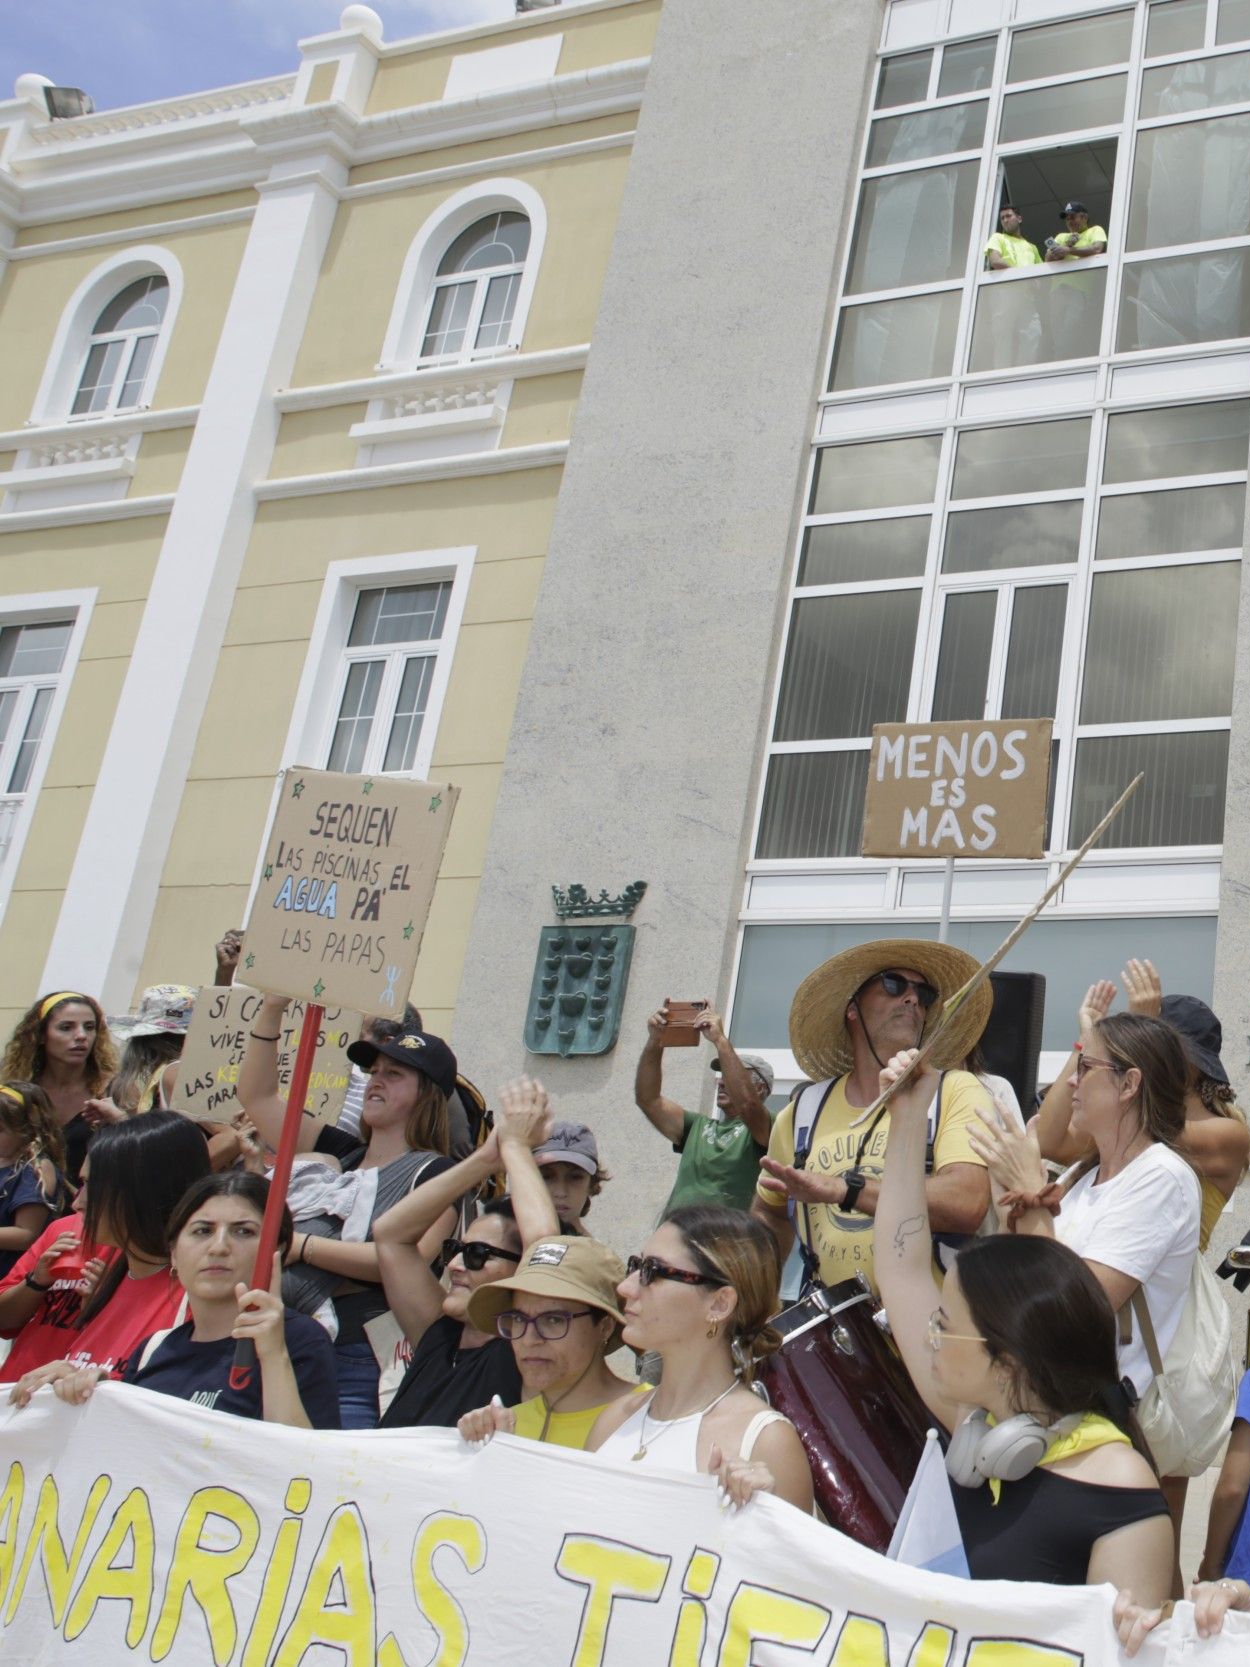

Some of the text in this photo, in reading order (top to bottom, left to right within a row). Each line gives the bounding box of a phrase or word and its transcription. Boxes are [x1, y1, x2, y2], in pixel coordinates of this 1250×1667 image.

[876, 729, 1028, 782] MENOS
[929, 778, 966, 808] ES
[309, 801, 398, 847] SEQUEN
[276, 841, 304, 871] LAS
[390, 864, 410, 890] EL
[273, 875, 338, 919] AGUA
[281, 928, 386, 973] LAS PAPAS
[185, 1071, 214, 1098] LAS
